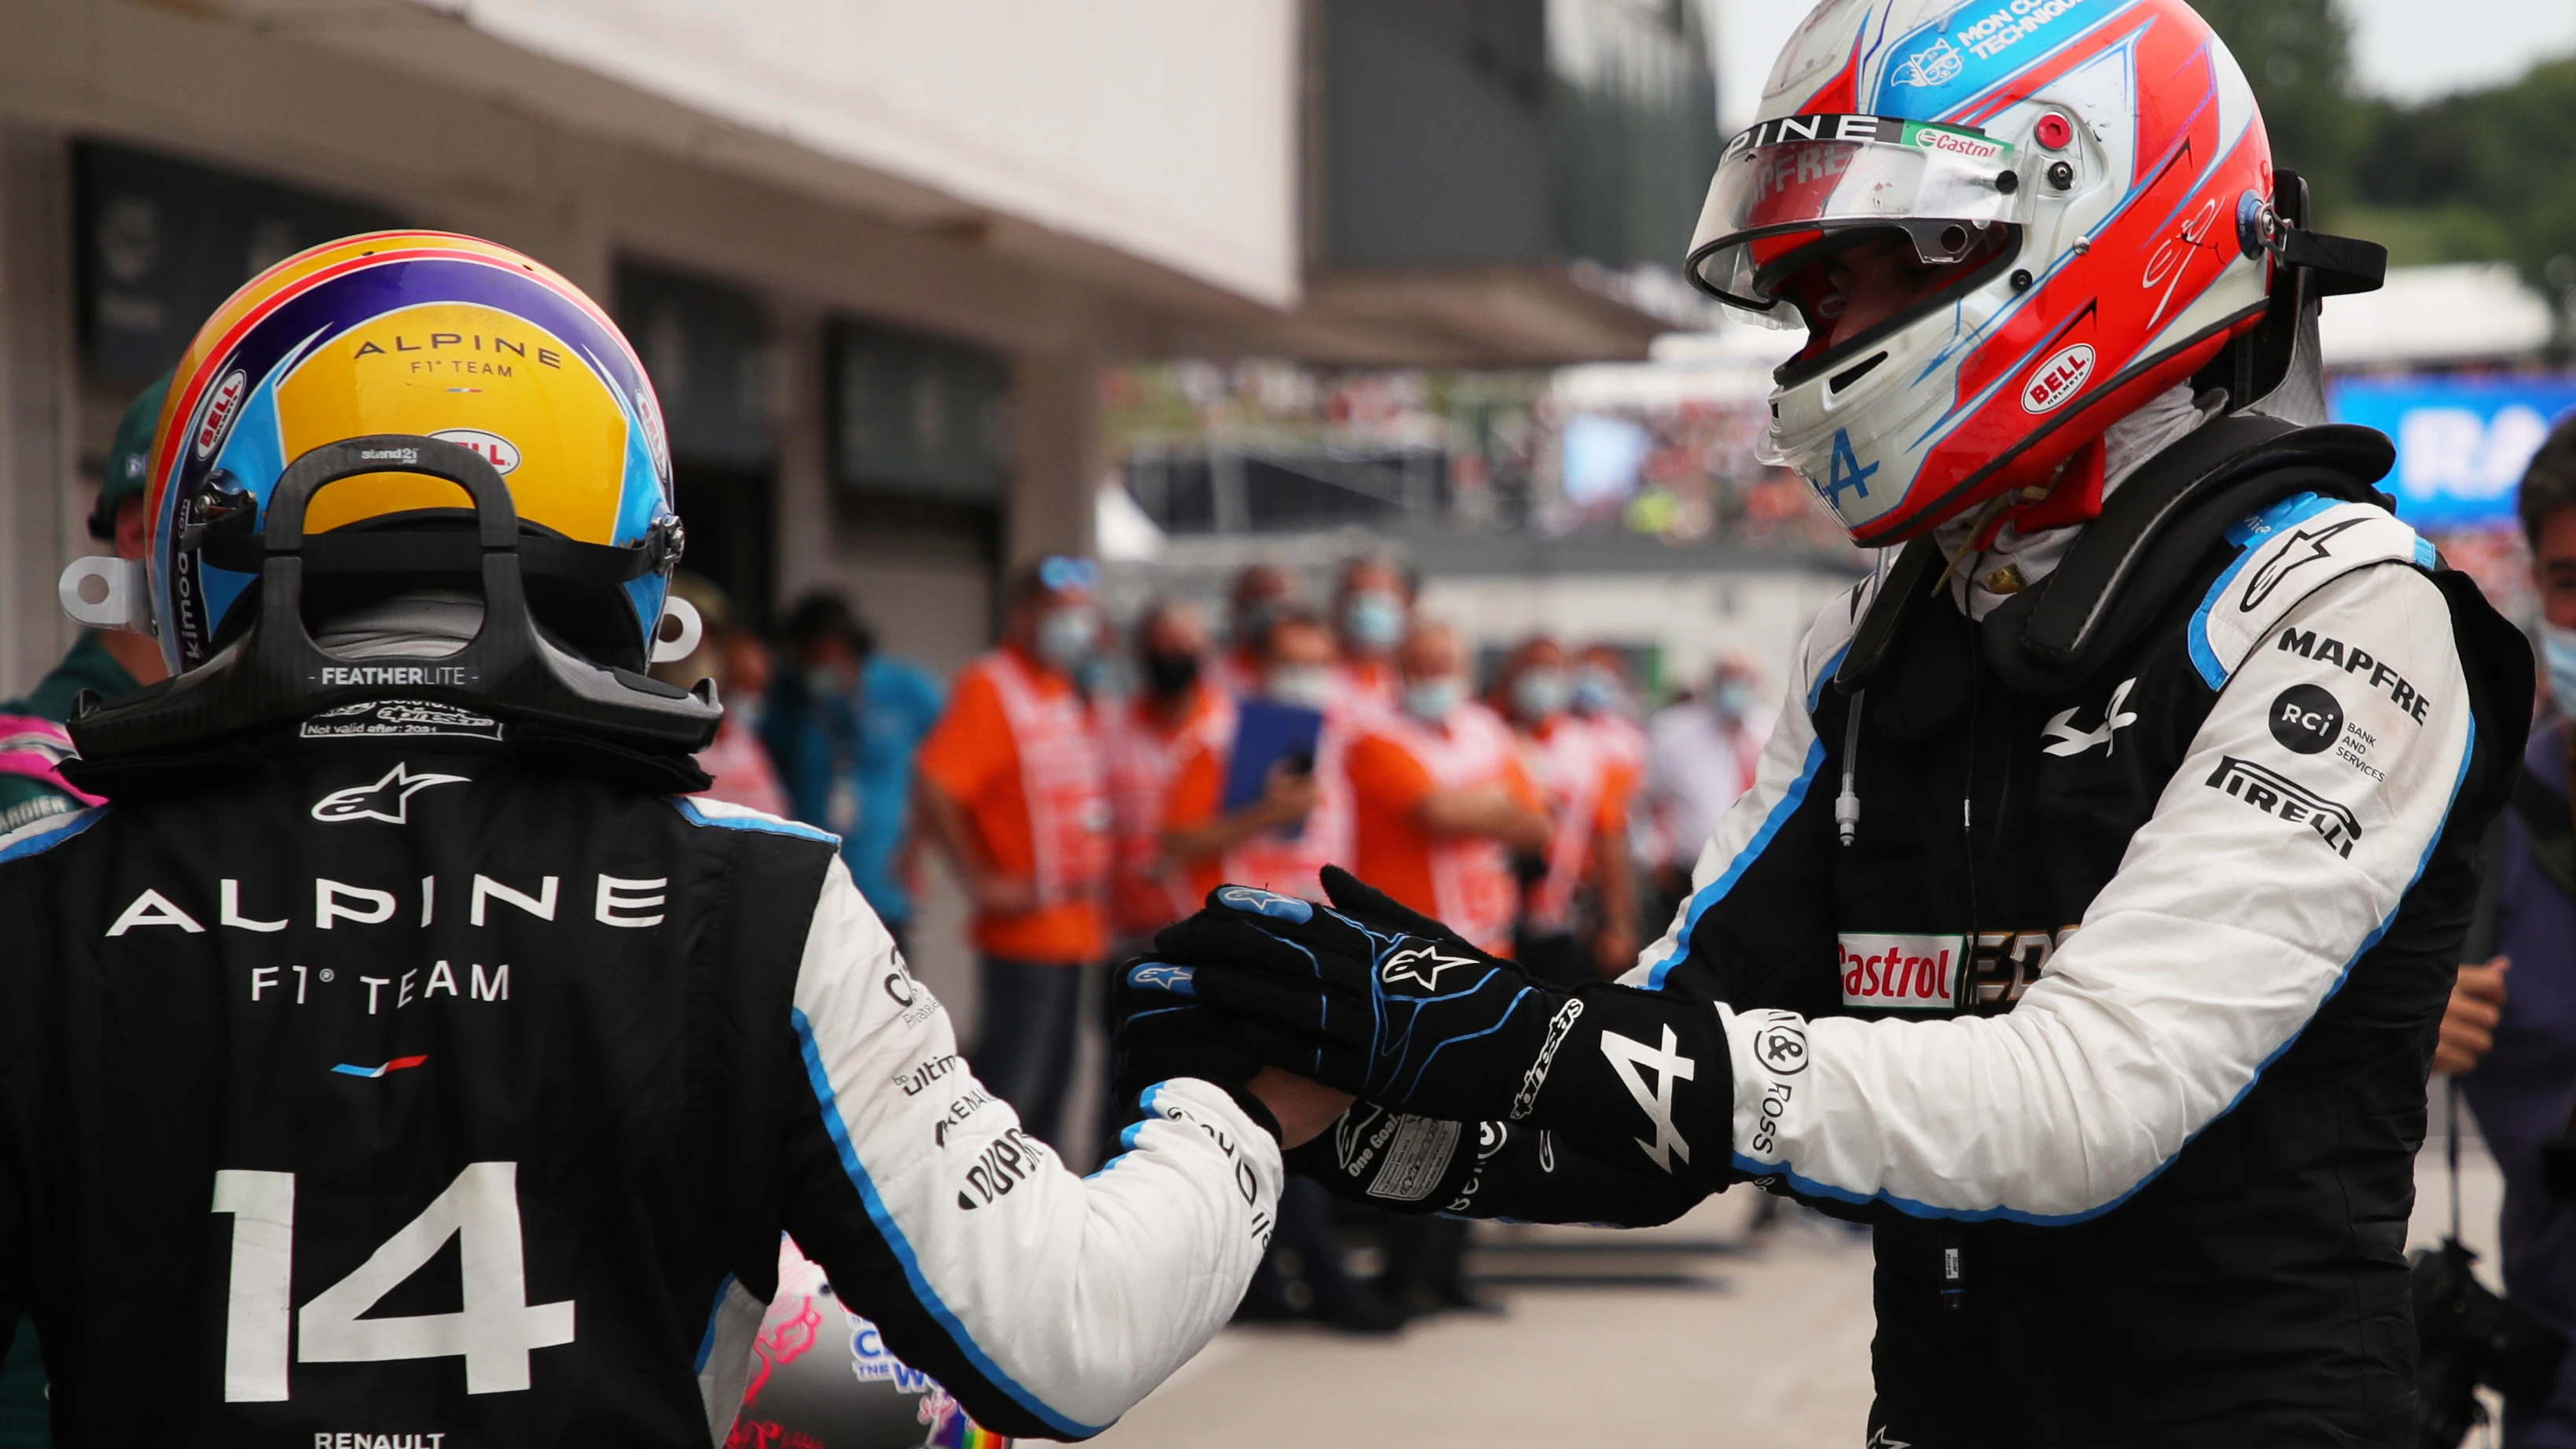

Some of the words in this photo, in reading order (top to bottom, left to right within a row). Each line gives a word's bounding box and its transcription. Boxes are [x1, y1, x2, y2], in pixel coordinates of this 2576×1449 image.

[1957, 9, 2014, 46] MON
[1968, 0, 2083, 60] TECHNIQ
[1936, 134, 1997, 156] Castrol
[353, 333, 561, 370] ALPINE
[452, 361, 512, 377] TEAM
[2029, 355, 2087, 406] BELL
[199, 384, 240, 449] BELL
[322, 667, 465, 686] FEATHERLITE
[2277, 627, 2431, 726] MAPFRE
[307, 724, 331, 735] Not
[333, 723, 365, 734] valid
[2342, 735, 2366, 755] AND
[2346, 722, 2377, 748] BANK
[2335, 746, 2387, 783] SERVICES
[2204, 755, 2362, 860] PIRELLI
[105, 873, 667, 937] ALPINE
[359, 959, 509, 1015] TEAM
[1347, 1149, 1374, 1177] One
[210, 1160, 576, 1403] 14
[314, 1432, 446, 1449] RENAULT
